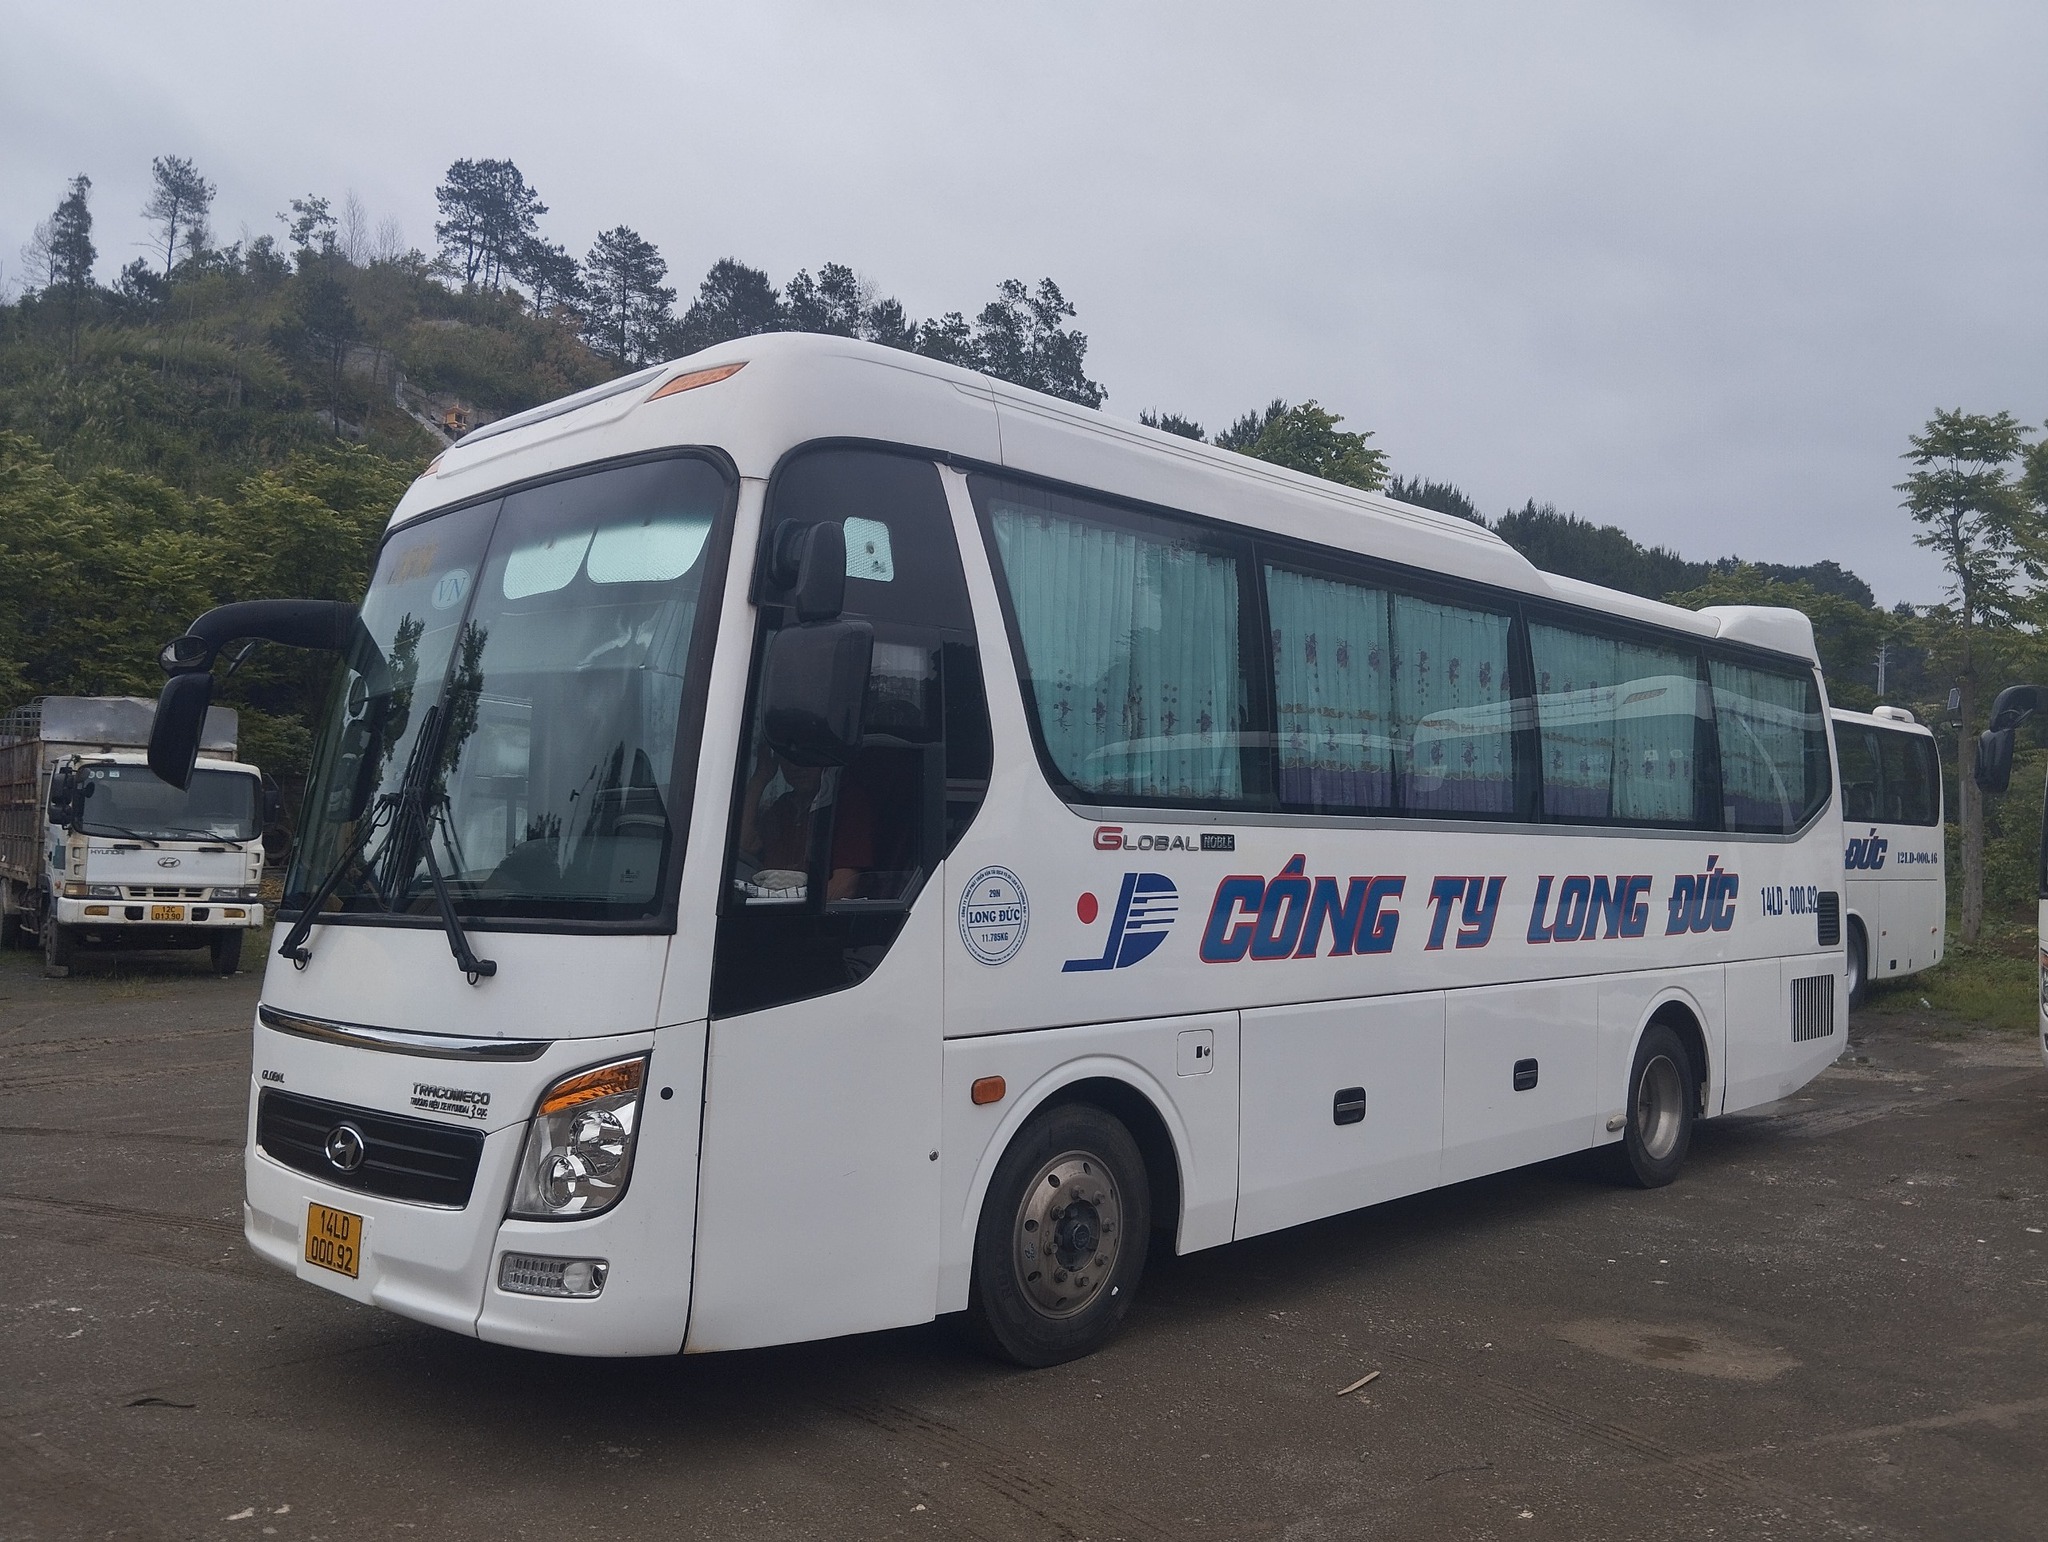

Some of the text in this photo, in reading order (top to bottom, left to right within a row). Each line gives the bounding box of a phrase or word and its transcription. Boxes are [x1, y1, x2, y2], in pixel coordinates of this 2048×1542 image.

[1093, 826, 1233, 851] GLOBAL NOBLE
[989, 889, 1000, 898] 29N
[1760, 886, 1783, 916] 14LD
[1790, 885, 1819, 914] 000.92
[155, 912, 181, 920] 013.90
[969, 906, 1020, 923] LONG ĐỨC
[1199, 853, 1739, 964] CÔNG TY LONG ĐỨC
[982, 932, 1008, 942] 11.785KG
[413, 1082, 491, 1105] TRACOMECO
[321, 1209, 350, 1241] 14LD
[311, 1235, 353, 1273] 000.92
